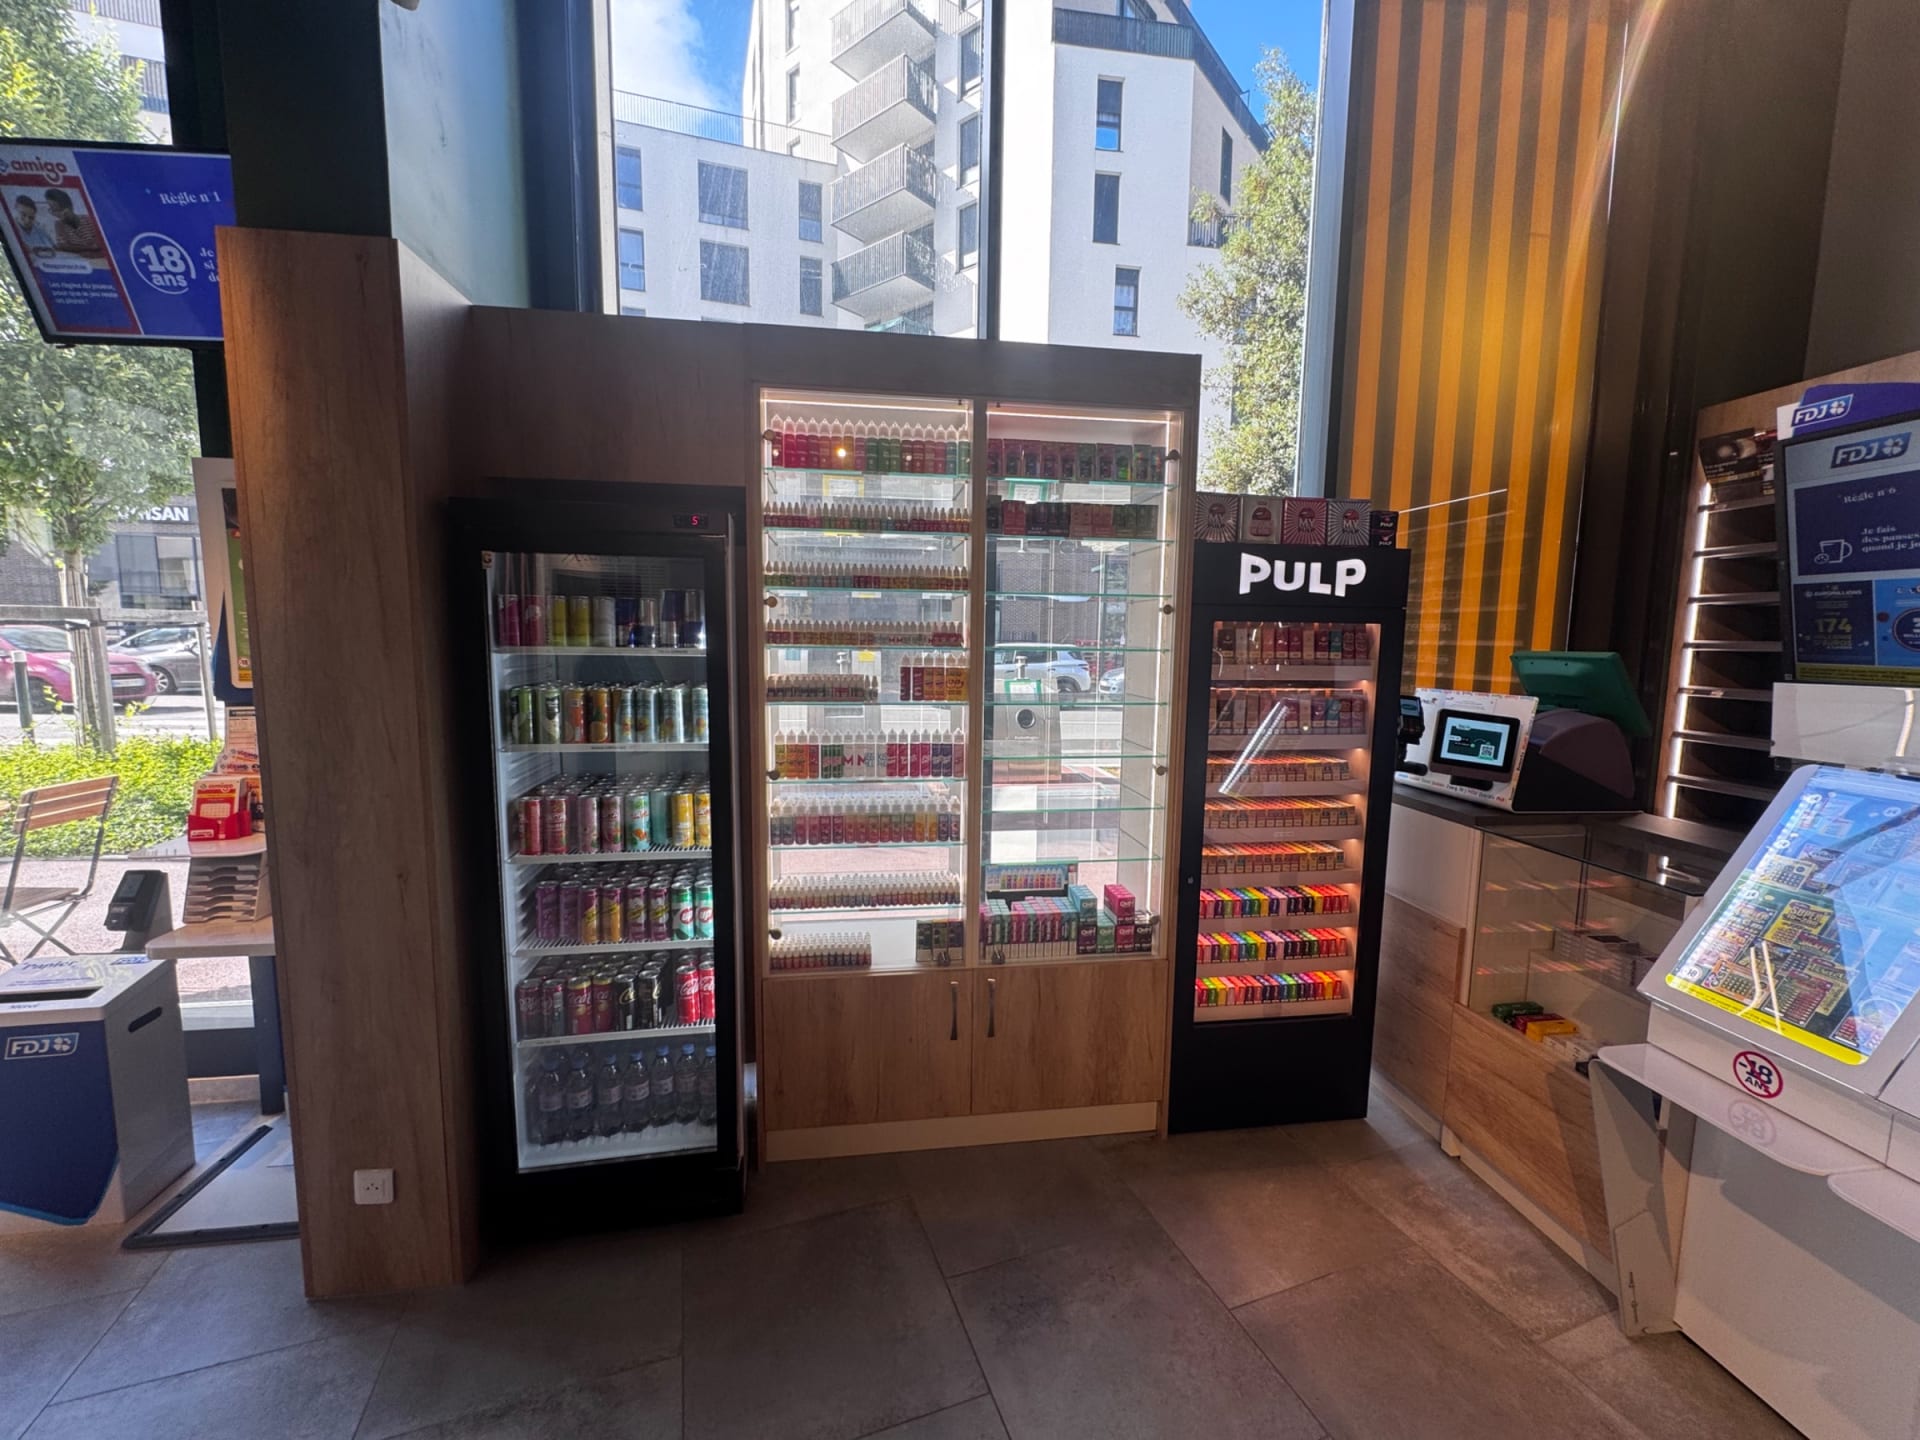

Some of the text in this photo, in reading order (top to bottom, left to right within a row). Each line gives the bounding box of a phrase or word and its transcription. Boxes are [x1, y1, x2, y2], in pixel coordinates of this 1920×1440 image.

[11, 156, 67, 184] amigo
[160, 191, 197, 205] Règle
[151, 273, 188, 287] ans
[1794, 406, 1828, 424] FDJ
[1835, 442, 1879, 465] FDJ
[1239, 552, 1366, 597] PULP
[11, 1039, 51, 1055] FDJ
